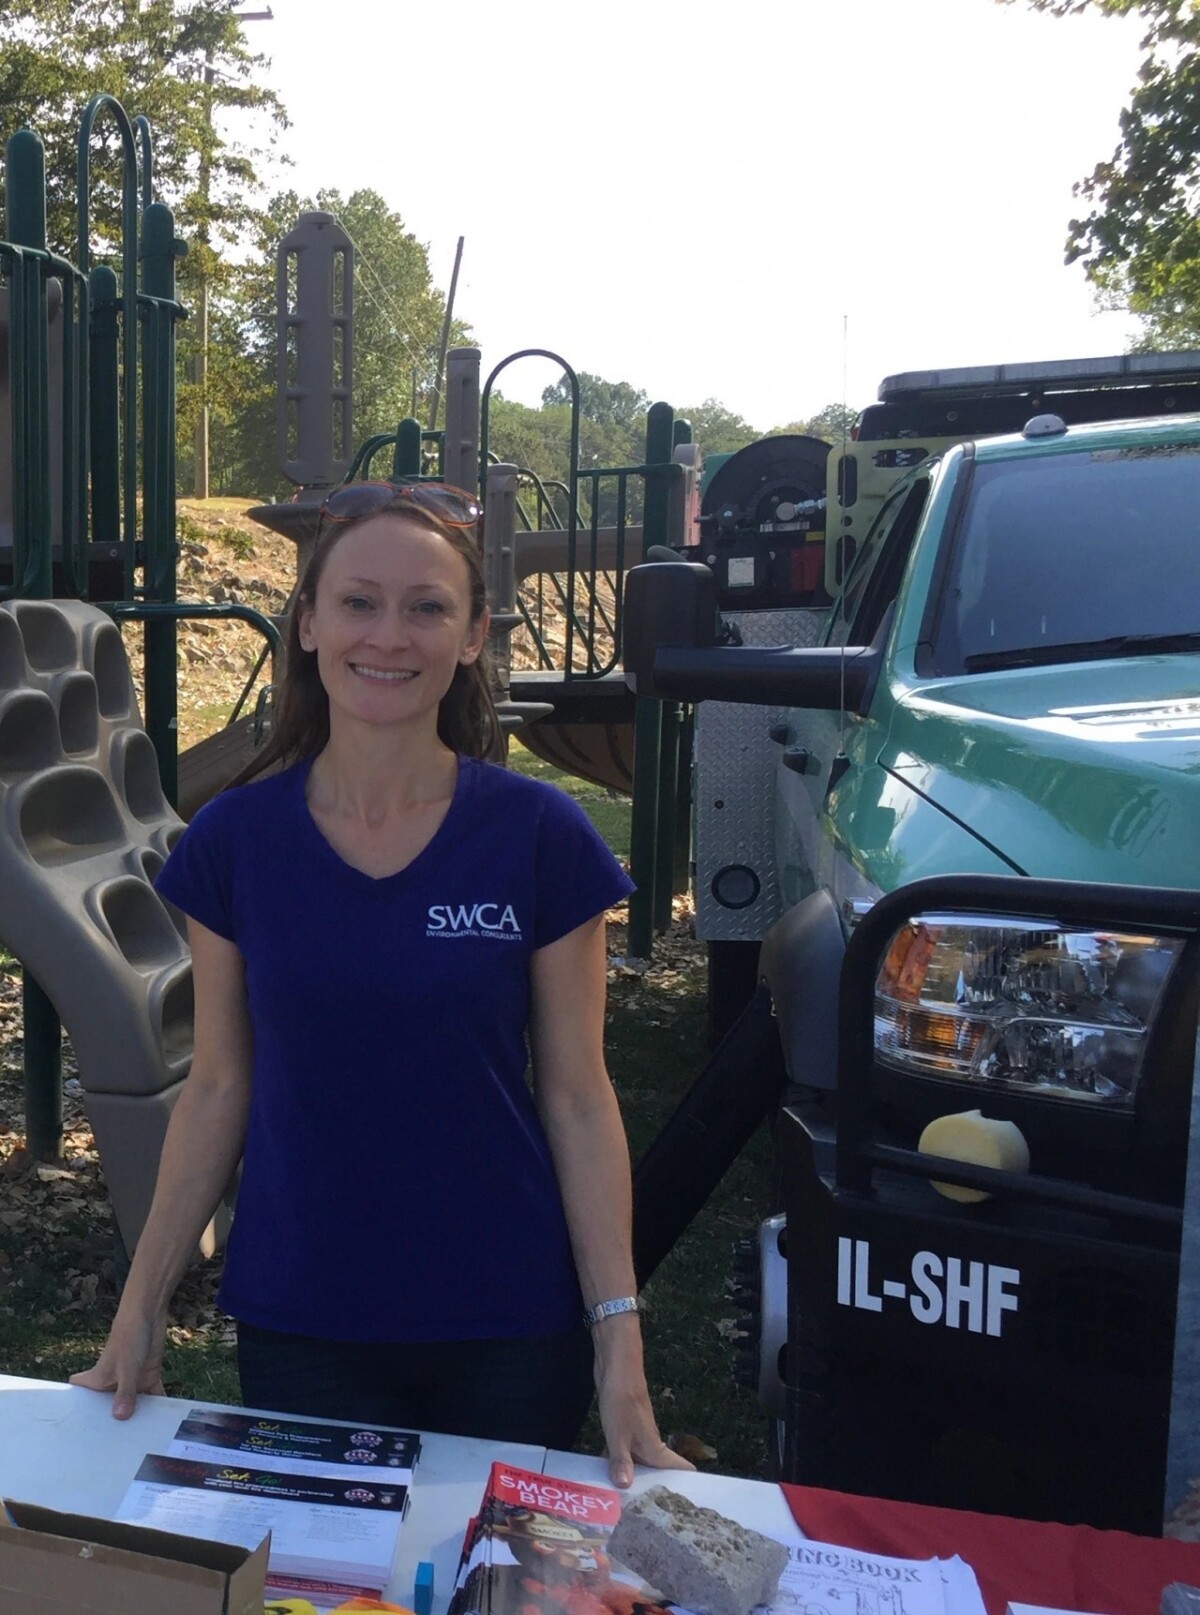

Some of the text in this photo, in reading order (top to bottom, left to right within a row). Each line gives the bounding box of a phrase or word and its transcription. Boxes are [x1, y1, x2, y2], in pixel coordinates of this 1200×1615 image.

[426, 903, 522, 932] SWCA
[836, 1236, 1021, 1338] IL-SHF
[499, 1475, 615, 1511] SMOKEY
[519, 1491, 589, 1519] BEAR
[786, 1545, 842, 1567] ING
[843, 1556, 923, 1583] BOOK
